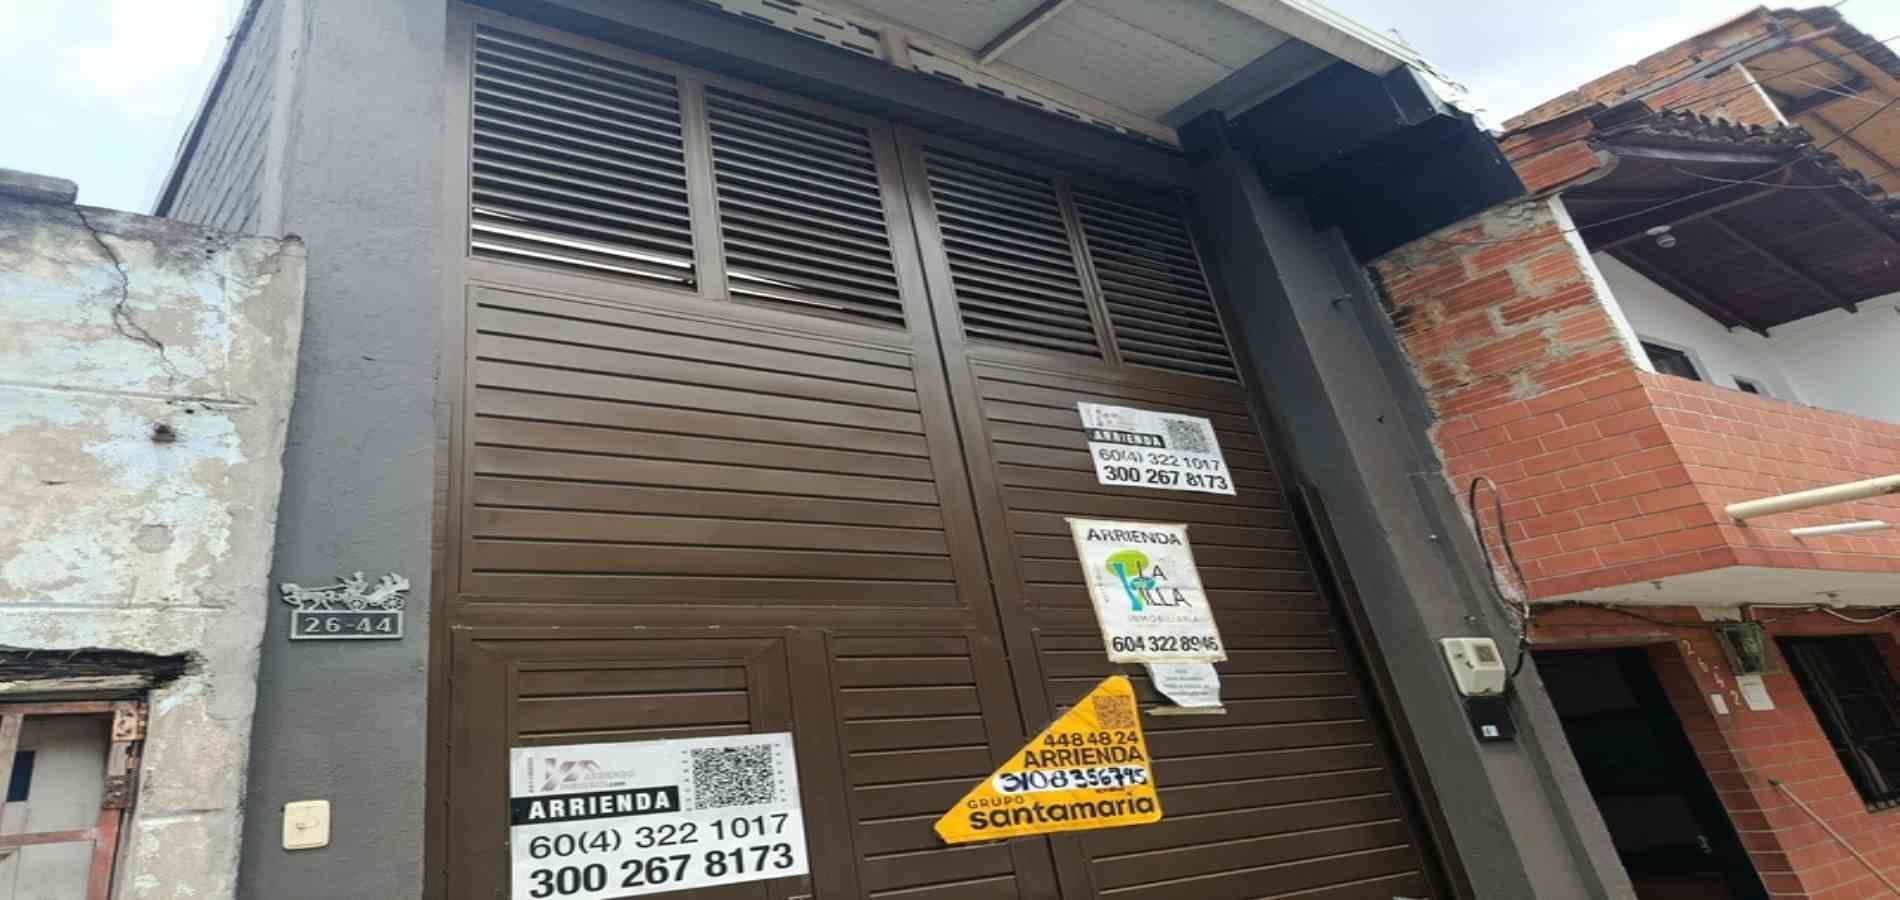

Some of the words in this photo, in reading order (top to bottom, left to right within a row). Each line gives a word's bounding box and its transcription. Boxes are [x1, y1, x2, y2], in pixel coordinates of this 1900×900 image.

[1099, 448, 1143, 463] 60(4)
[1148, 453, 1180, 467] 322
[1183, 457, 1220, 471] 1017
[1103, 465, 1140, 483] 300
[1145, 468, 1180, 485] 267
[1186, 472, 1228, 490] 8173
[1087, 528, 1182, 546] ARRIENDA
[304, 616, 392, 632] 26-44
[1112, 636, 1146, 652] 604
[1149, 636, 1178, 652] 322
[1044, 732, 1084, 748] 448
[1087, 732, 1111, 747] 48
[1115, 731, 1138, 745] 24
[1024, 746, 1144, 769] ARRIENDA
[528, 791, 671, 820] ARRIENDA
[967, 796, 1024, 810] GRUPO
[529, 829, 622, 860] 60(4)
[635, 822, 699, 849] 322
[709, 813, 790, 841] 1017
[529, 863, 608, 899] 300
[620, 854, 692, 889] 267
[704, 843, 794, 878] 8173
